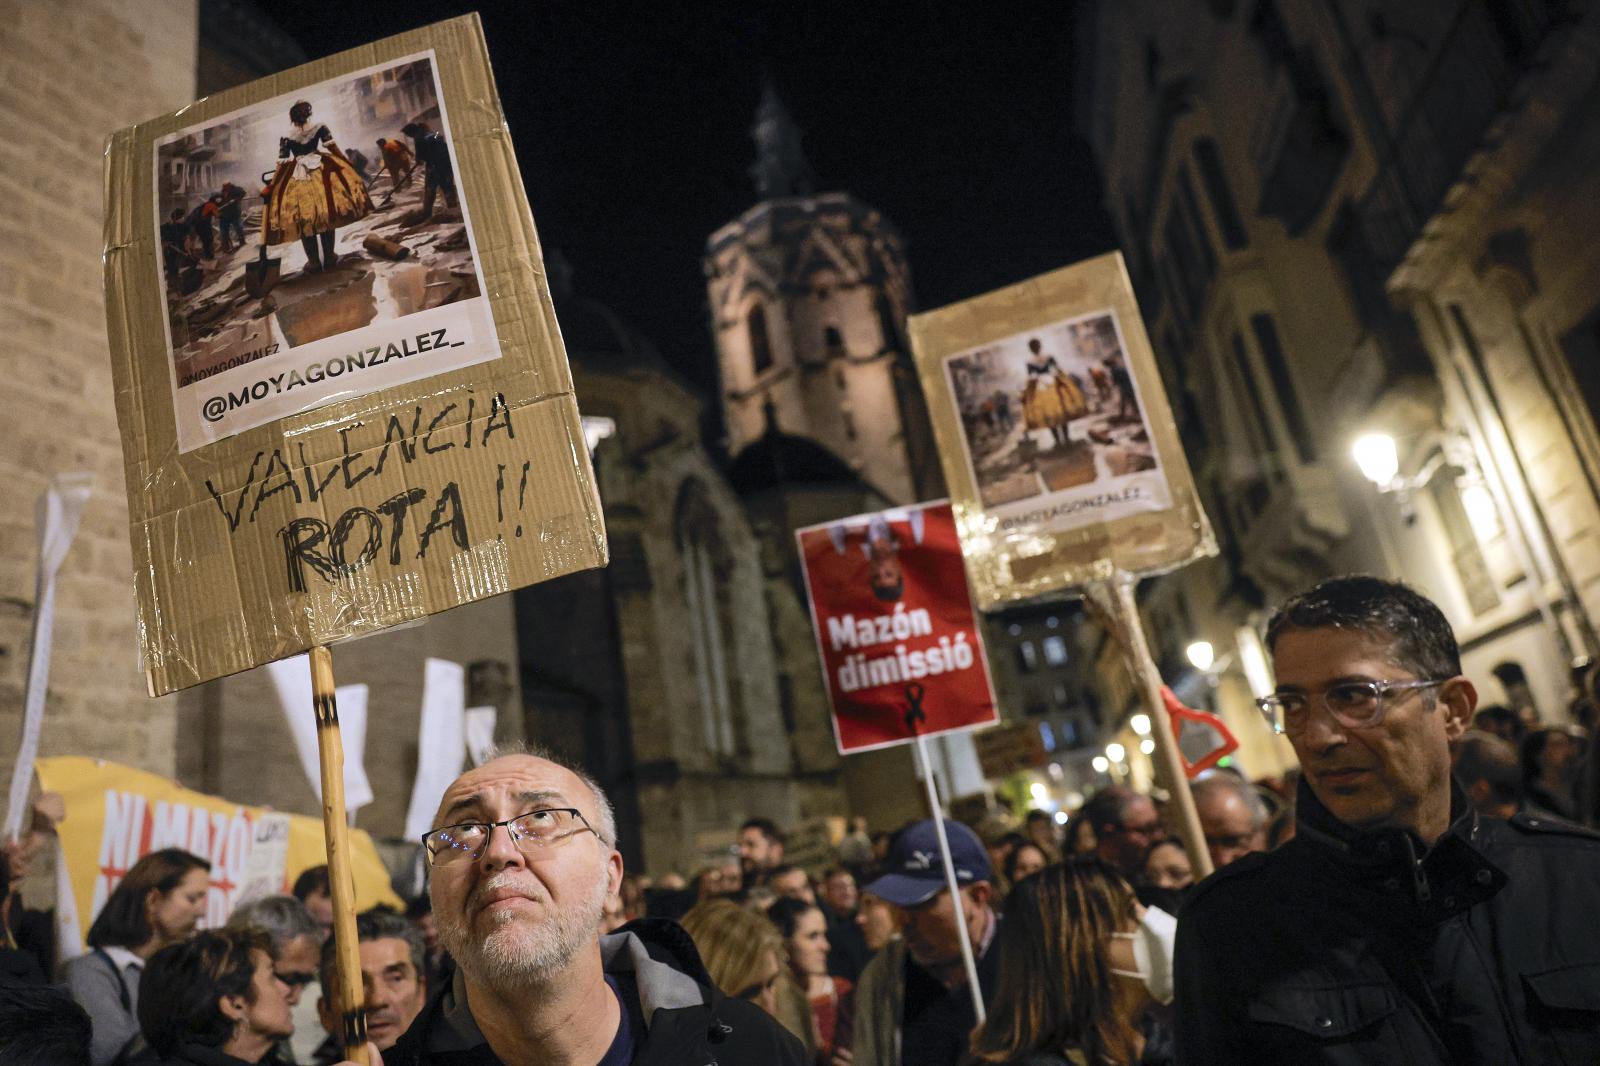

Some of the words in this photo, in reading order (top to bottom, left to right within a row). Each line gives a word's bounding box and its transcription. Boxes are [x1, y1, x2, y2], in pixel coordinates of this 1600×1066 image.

[202, 328, 465, 422] @MOYAGONZALEZ_
[205, 390, 514, 533] VALENCIA
[827, 602, 932, 650] Mazón
[838, 632, 974, 693] dimissió
